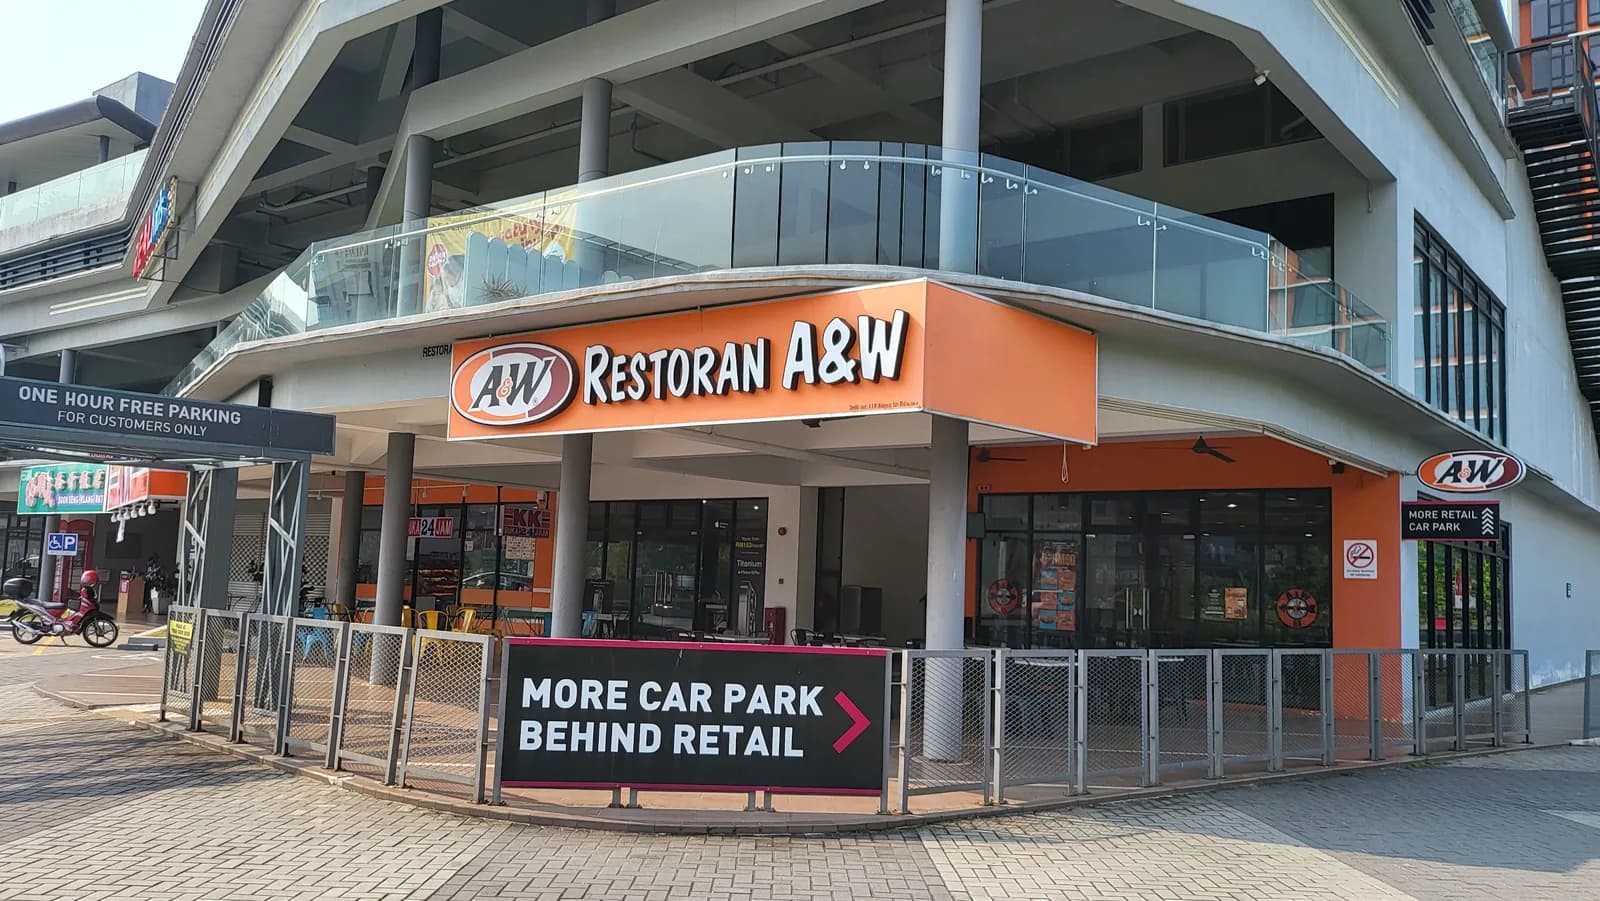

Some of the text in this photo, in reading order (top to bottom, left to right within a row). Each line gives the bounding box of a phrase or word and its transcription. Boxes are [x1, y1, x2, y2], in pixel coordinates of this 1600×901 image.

[583, 309, 909, 405] RESTORAN A&W
[470, 357, 554, 412] A&W
[19, 386, 241, 425] ONE HOUR FREE PARKING
[57, 410, 207, 437] FOR CUSTOMERS ONLY
[1436, 458, 1505, 484] A&W
[421, 519, 434, 536] 24
[435, 519, 452, 536] JAM
[1409, 510, 1478, 519] MORE RETAIL
[1409, 522, 1461, 532] CAR PARK
[64, 536, 76, 549] P
[522, 677, 824, 716] MORE CAR PARK
[519, 720, 804, 757] BEHIND RETAIL
